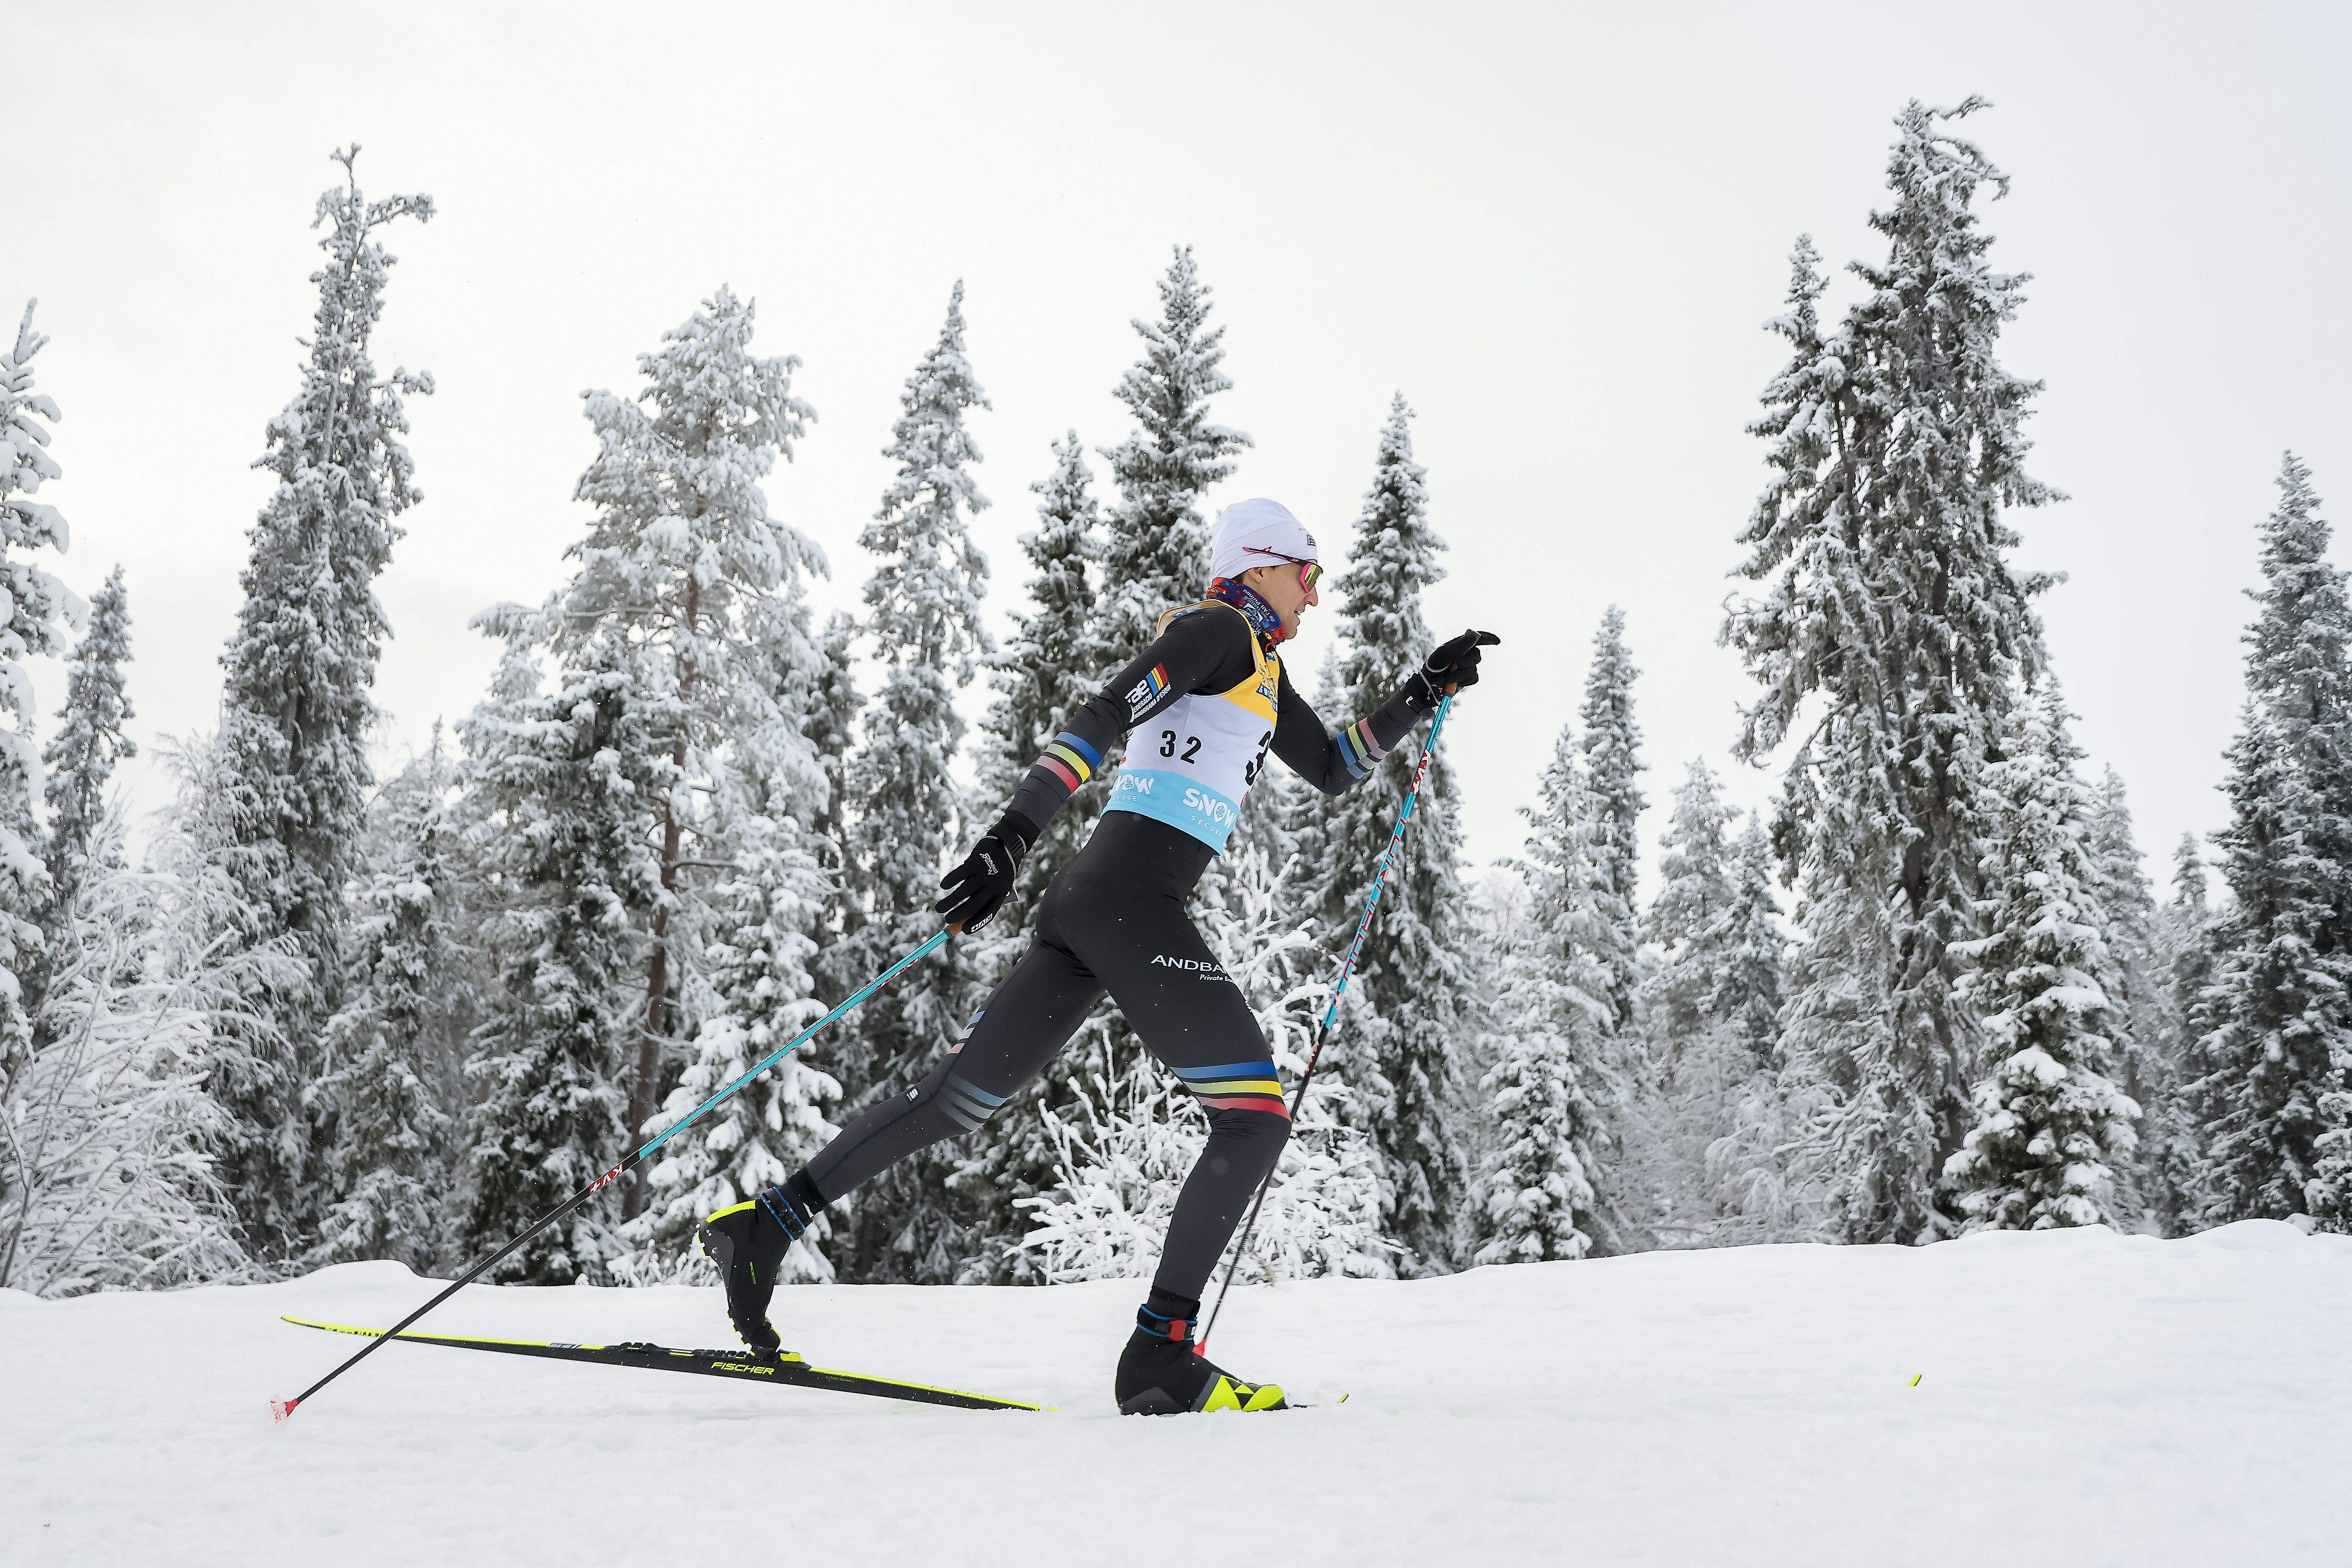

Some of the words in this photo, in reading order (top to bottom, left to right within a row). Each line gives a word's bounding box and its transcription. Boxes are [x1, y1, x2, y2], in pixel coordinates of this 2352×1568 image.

[1160, 729, 1202, 765] 32
[1182, 787, 1238, 830] SNOW
[1190, 814, 1223, 838] SECURE
[590, 1163, 623, 1192] KV+
[711, 1361, 775, 1375] FISCHER
